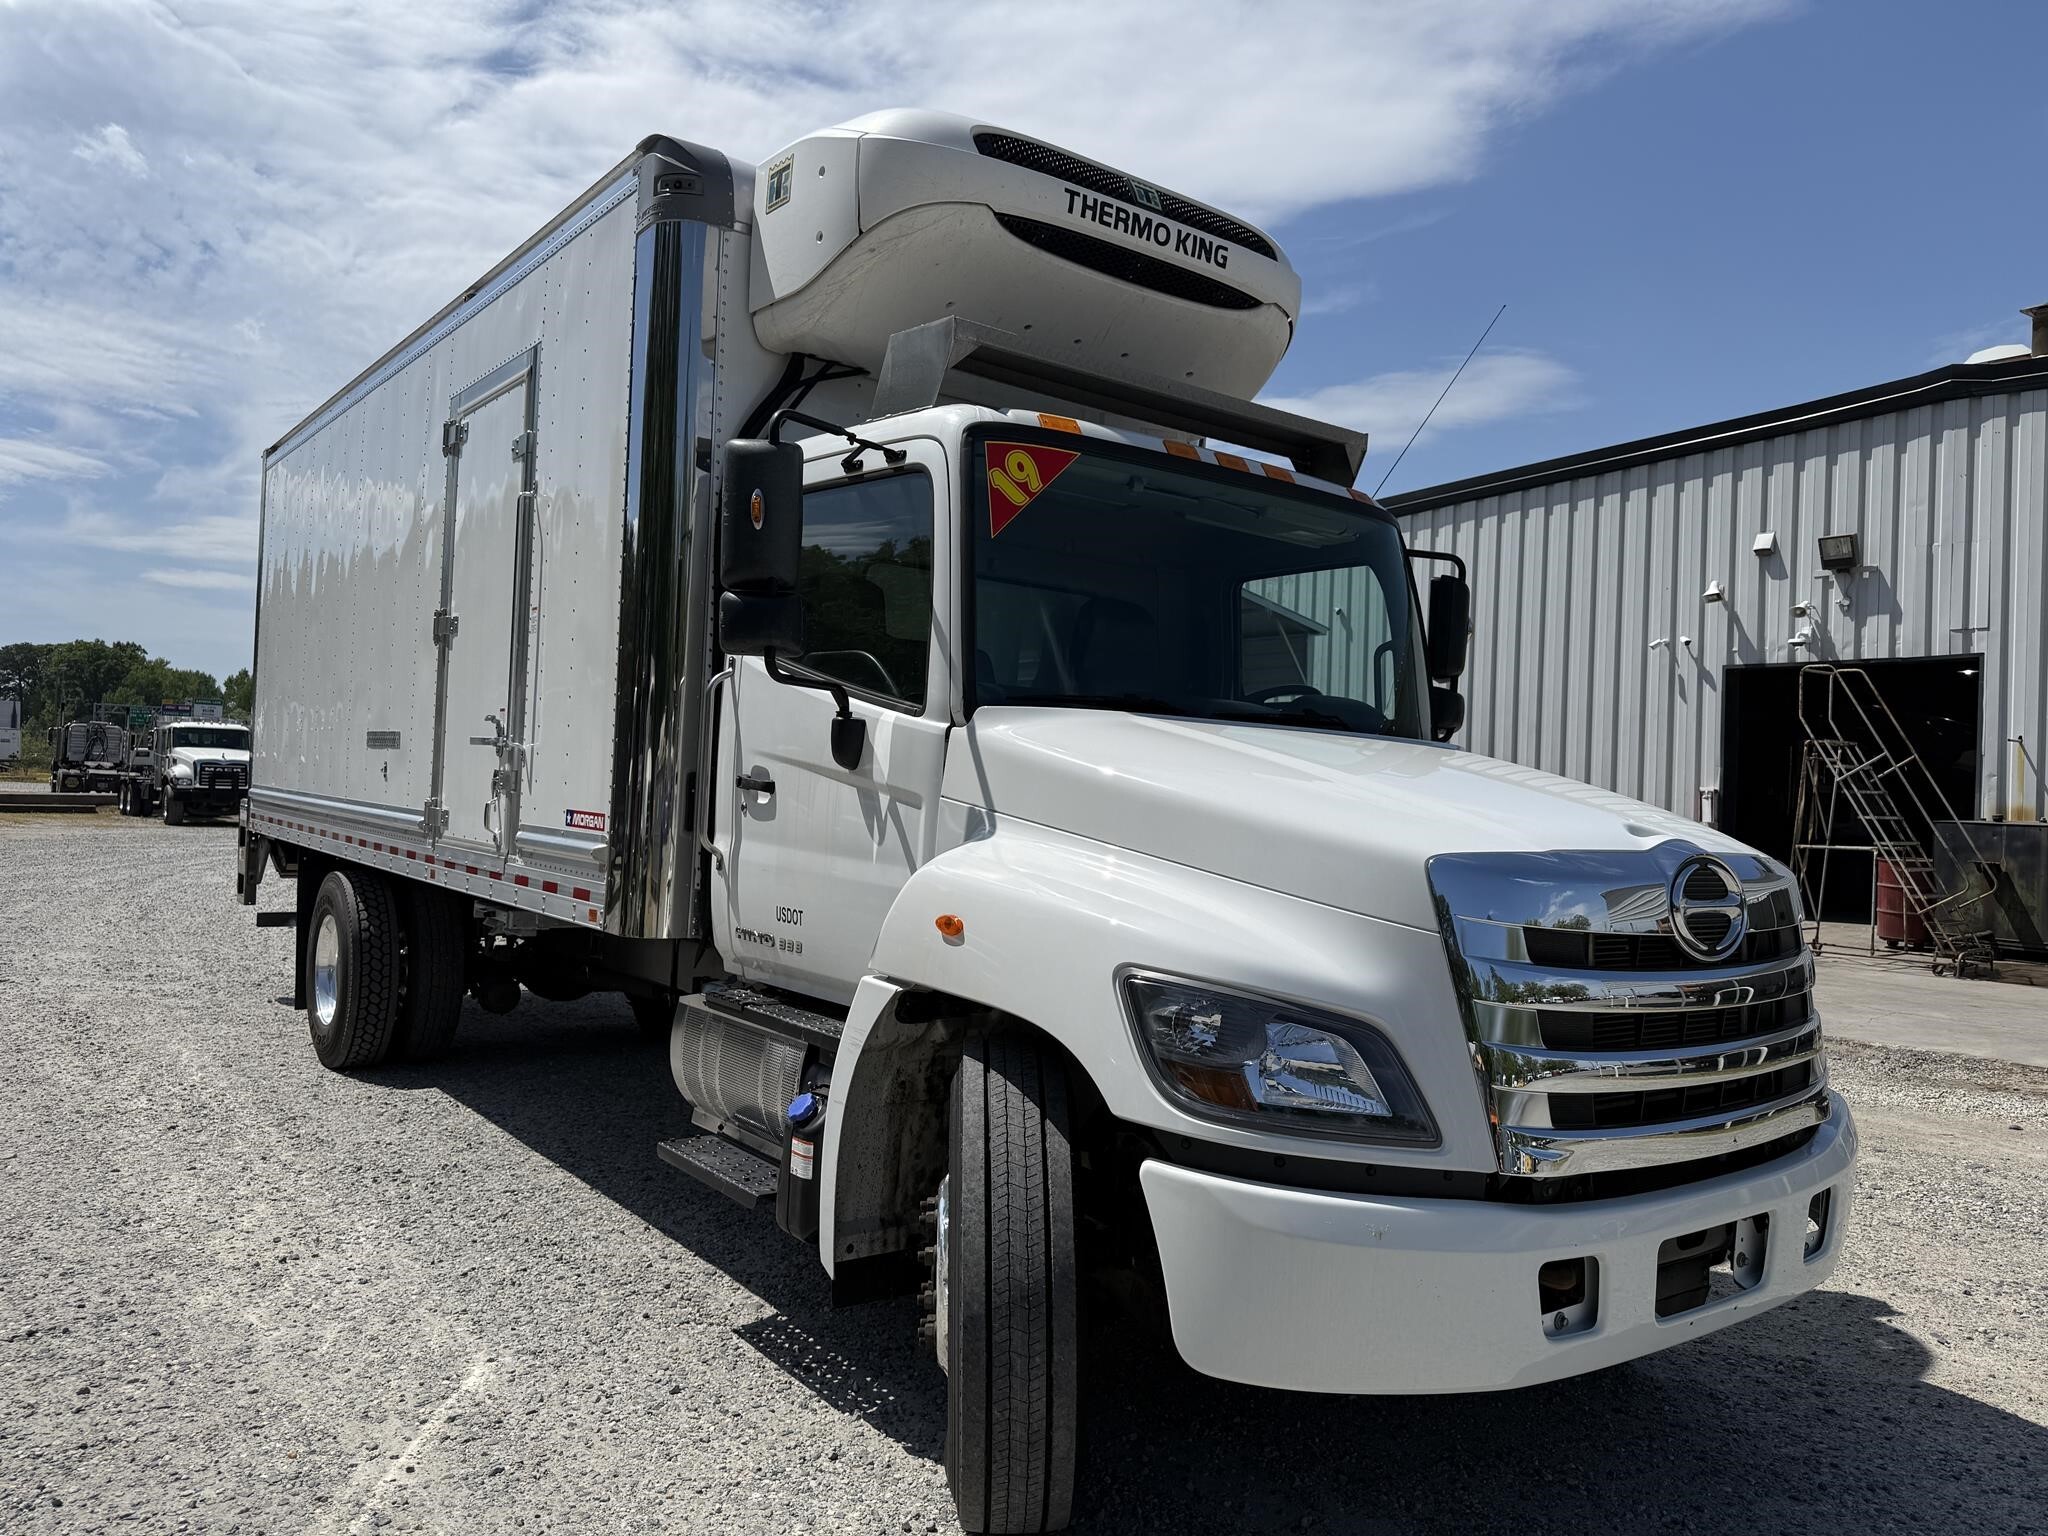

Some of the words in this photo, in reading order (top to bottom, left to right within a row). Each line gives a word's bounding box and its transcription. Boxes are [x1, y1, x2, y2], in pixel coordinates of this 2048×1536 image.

[1064, 187, 1171, 247] THERMO
[1174, 228, 1229, 270] KING
[988, 449, 1043, 506] 19
[572, 812, 604, 829] MORGAN
[776, 905, 804, 927] USDOT
